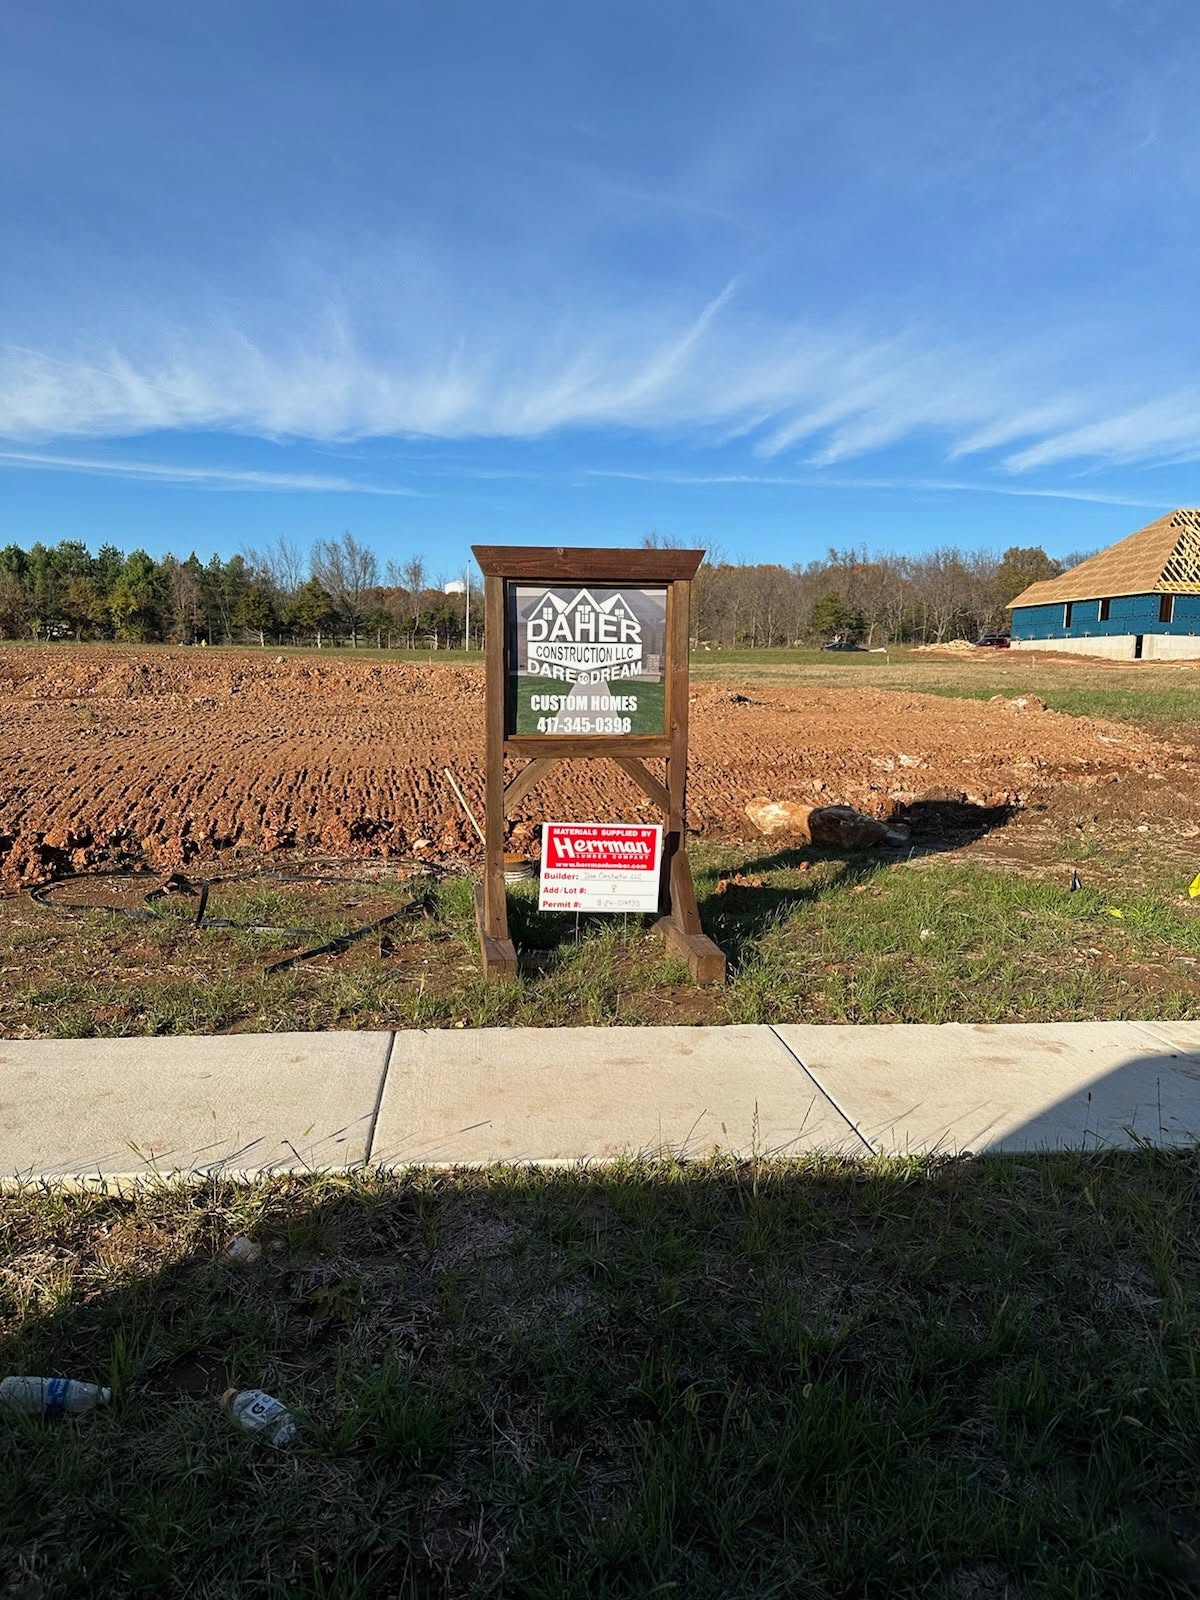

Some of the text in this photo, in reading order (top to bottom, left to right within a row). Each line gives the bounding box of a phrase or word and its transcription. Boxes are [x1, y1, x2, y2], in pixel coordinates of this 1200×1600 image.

[527, 612, 642, 643] DAHER
[536, 646, 634, 663] CONSTRUCTION LLC
[527, 659, 577, 684] DARE
[590, 661, 642, 685] DREAM
[530, 695, 638, 711] CUSTOM HOMES
[537, 717, 632, 733] 417-345-0398
[553, 828, 598, 836] MATERIALS
[601, 829, 638, 837] SUPPLIED
[552, 837, 652, 859] Herrman
[555, 861, 647, 870] www.herrmanlumber.com
[544, 872, 579, 880] Builder:
[543, 886, 577, 894] Add/Lot
[542, 900, 571, 908] Permit
